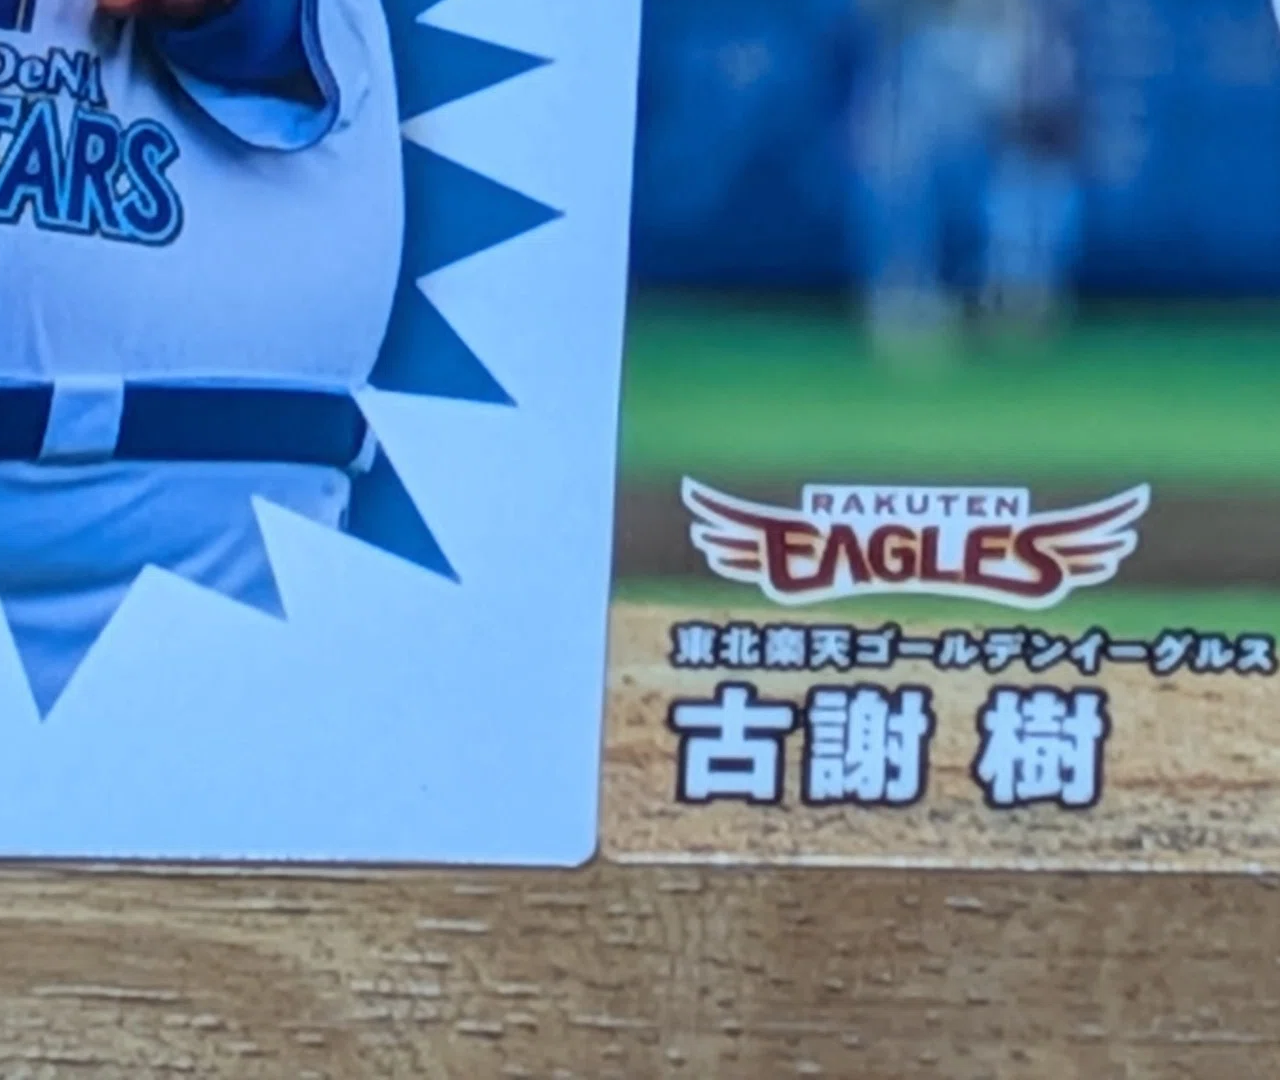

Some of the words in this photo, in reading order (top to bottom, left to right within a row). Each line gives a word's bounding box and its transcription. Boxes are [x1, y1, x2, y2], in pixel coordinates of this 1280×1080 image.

[810, 492, 1020, 516] RAKUTEN
[763, 523, 1065, 598] EAGLES
[671, 623, 1278, 673] 東北楽天ゴールデンイーグルス
[670, 684, 934, 804] 古謝
[974, 687, 1111, 808] 樹
